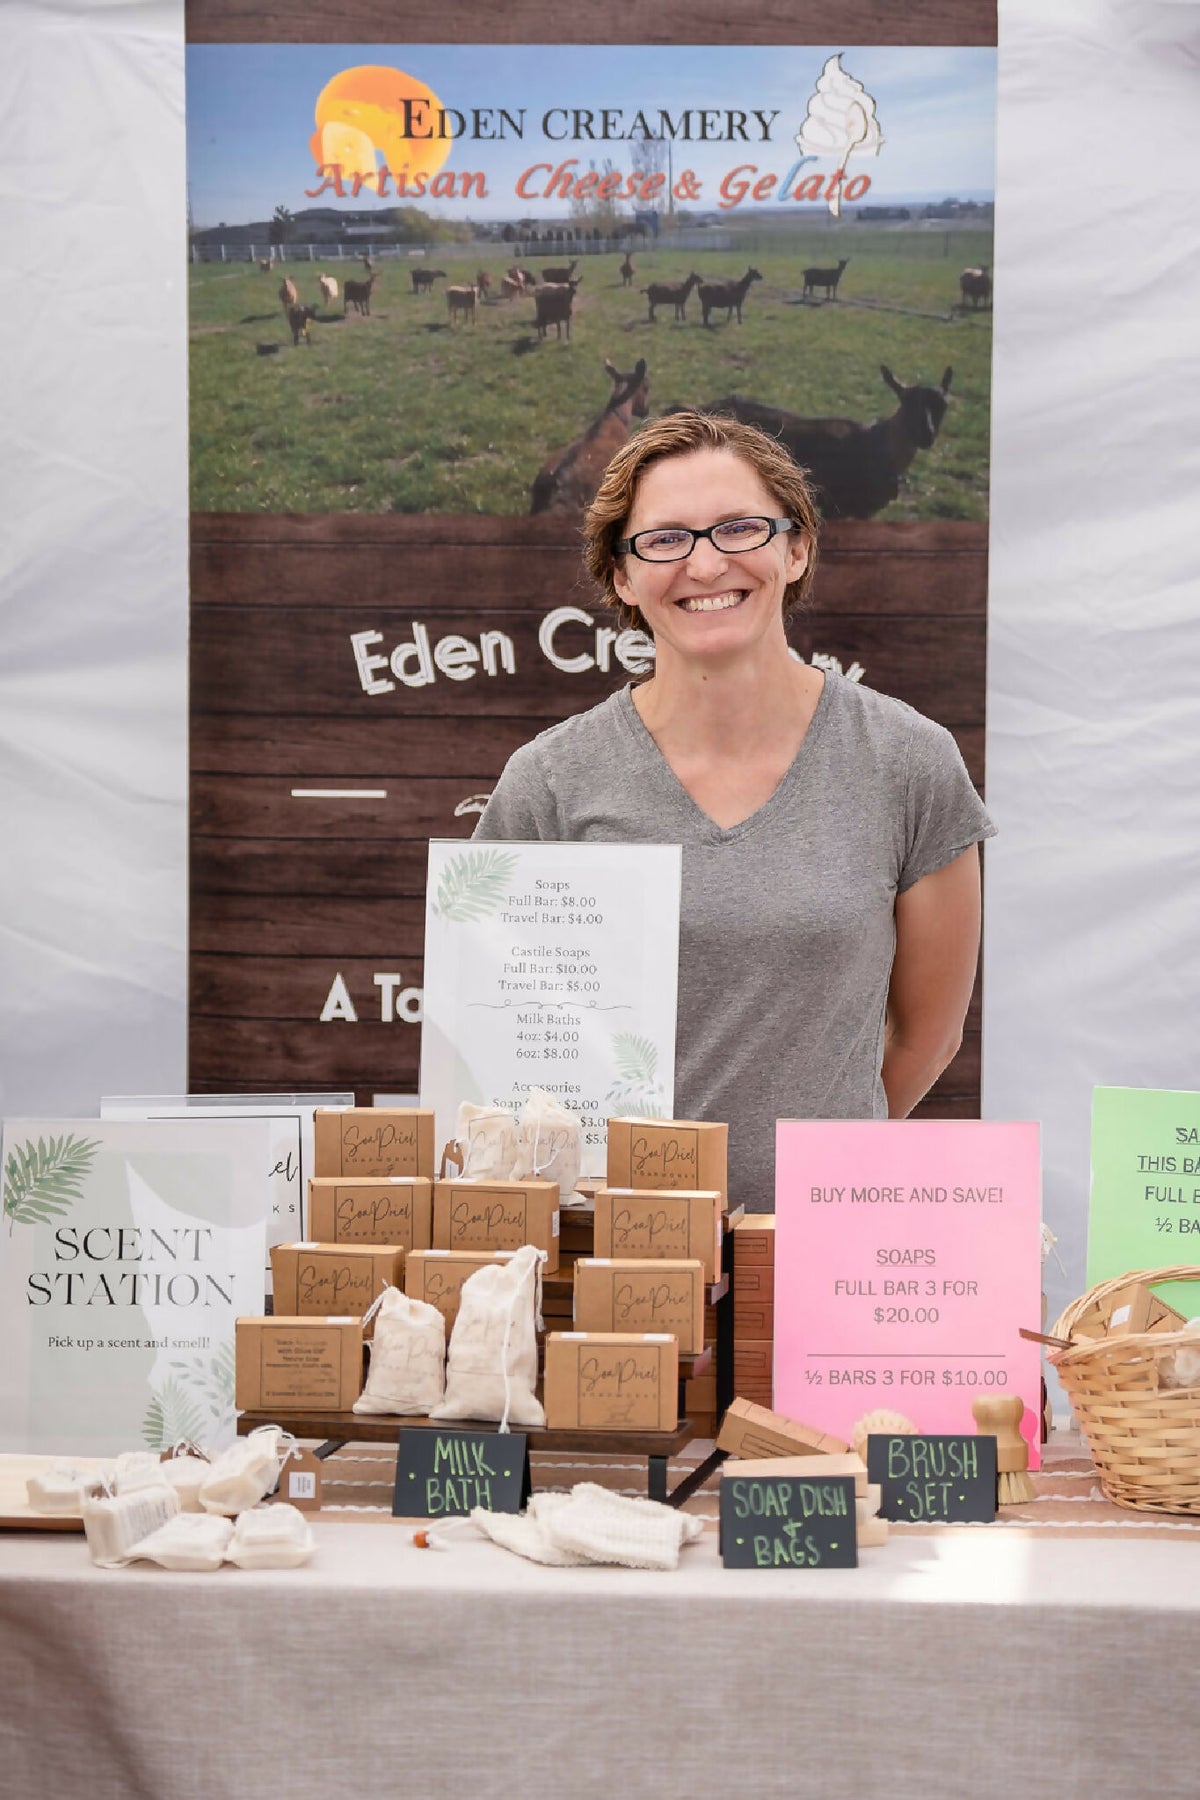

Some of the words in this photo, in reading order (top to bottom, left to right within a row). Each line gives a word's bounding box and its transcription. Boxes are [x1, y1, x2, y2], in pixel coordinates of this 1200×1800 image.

[399, 98, 527, 140] EDEN
[541, 108, 780, 141] CREAMERY
[304, 163, 489, 198] Artisan
[514, 158, 666, 200] Cheese
[673, 168, 702, 200] &
[717, 155, 872, 210] Gelato
[350, 621, 516, 696] Eden
[535, 879, 570, 893] Soaps
[508, 895, 531, 907] Full
[534, 896, 558, 907] Bar:
[561, 896, 596, 908] $8.00
[500, 912, 538, 924] Travel
[541, 912, 565, 924] Bar:
[568, 913, 603, 925] $4.00
[511, 945, 552, 958] Castile
[555, 947, 591, 960] Soaps
[503, 962, 526, 974] Full
[530, 963, 553, 975] Bar:
[556, 963, 598, 975] $10.00
[498, 979, 536, 991] Travel
[540, 980, 563, 992] Bar:
[566, 980, 601, 992] $5.00
[319, 971, 358, 1022] A
[516, 1013, 544, 1026] Milk
[546, 1013, 581, 1026] Baths
[516, 1031, 541, 1042] 4oz:
[543, 1031, 579, 1043] $4.00
[516, 1048, 541, 1060] 6oz:
[543, 1047, 579, 1060] $8.00
[512, 1081, 581, 1094] Accssories
[492, 1098, 522, 1112] Soap
[564, 1099, 599, 1111] $2.00
[1137, 1155, 1177, 1173] THIS
[810, 1187, 846, 1203] BUY
[851, 1187, 905, 1203] MORE
[909, 1187, 948, 1203] AND
[952, 1187, 1004, 1203] SAVE!
[1144, 1186, 1187, 1204] FULL
[54, 1227, 213, 1262] SCENT
[876, 1249, 937, 1266] SOAPS
[26, 1272, 236, 1307] STATION
[834, 1280, 877, 1296] FULL
[883, 1280, 920, 1296] BAR
[924, 1280, 937, 1296] 3
[943, 1280, 979, 1296] FOR
[873, 1307, 940, 1325] $20.00
[48, 1336, 75, 1349] Pick
[77, 1338, 94, 1352] up
[96, 1339, 105, 1349] a
[107, 1338, 141, 1349] scent
[144, 1336, 168, 1349] and
[172, 1336, 211, 1349] smell!
[829, 1370, 877, 1386] BARS
[882, 1370, 895, 1386] 3
[900, 1370, 936, 1386] FOR
[942, 1370, 1008, 1387] $10.00
[433, 1436, 497, 1477] MILK
[888, 1438, 979, 1480] BRUSH
[426, 1477, 493, 1514] BATH
[732, 1480, 792, 1518] SOAP
[800, 1483, 848, 1518] DISH
[906, 1480, 953, 1519] SET
[753, 1535, 821, 1567] BAGS
